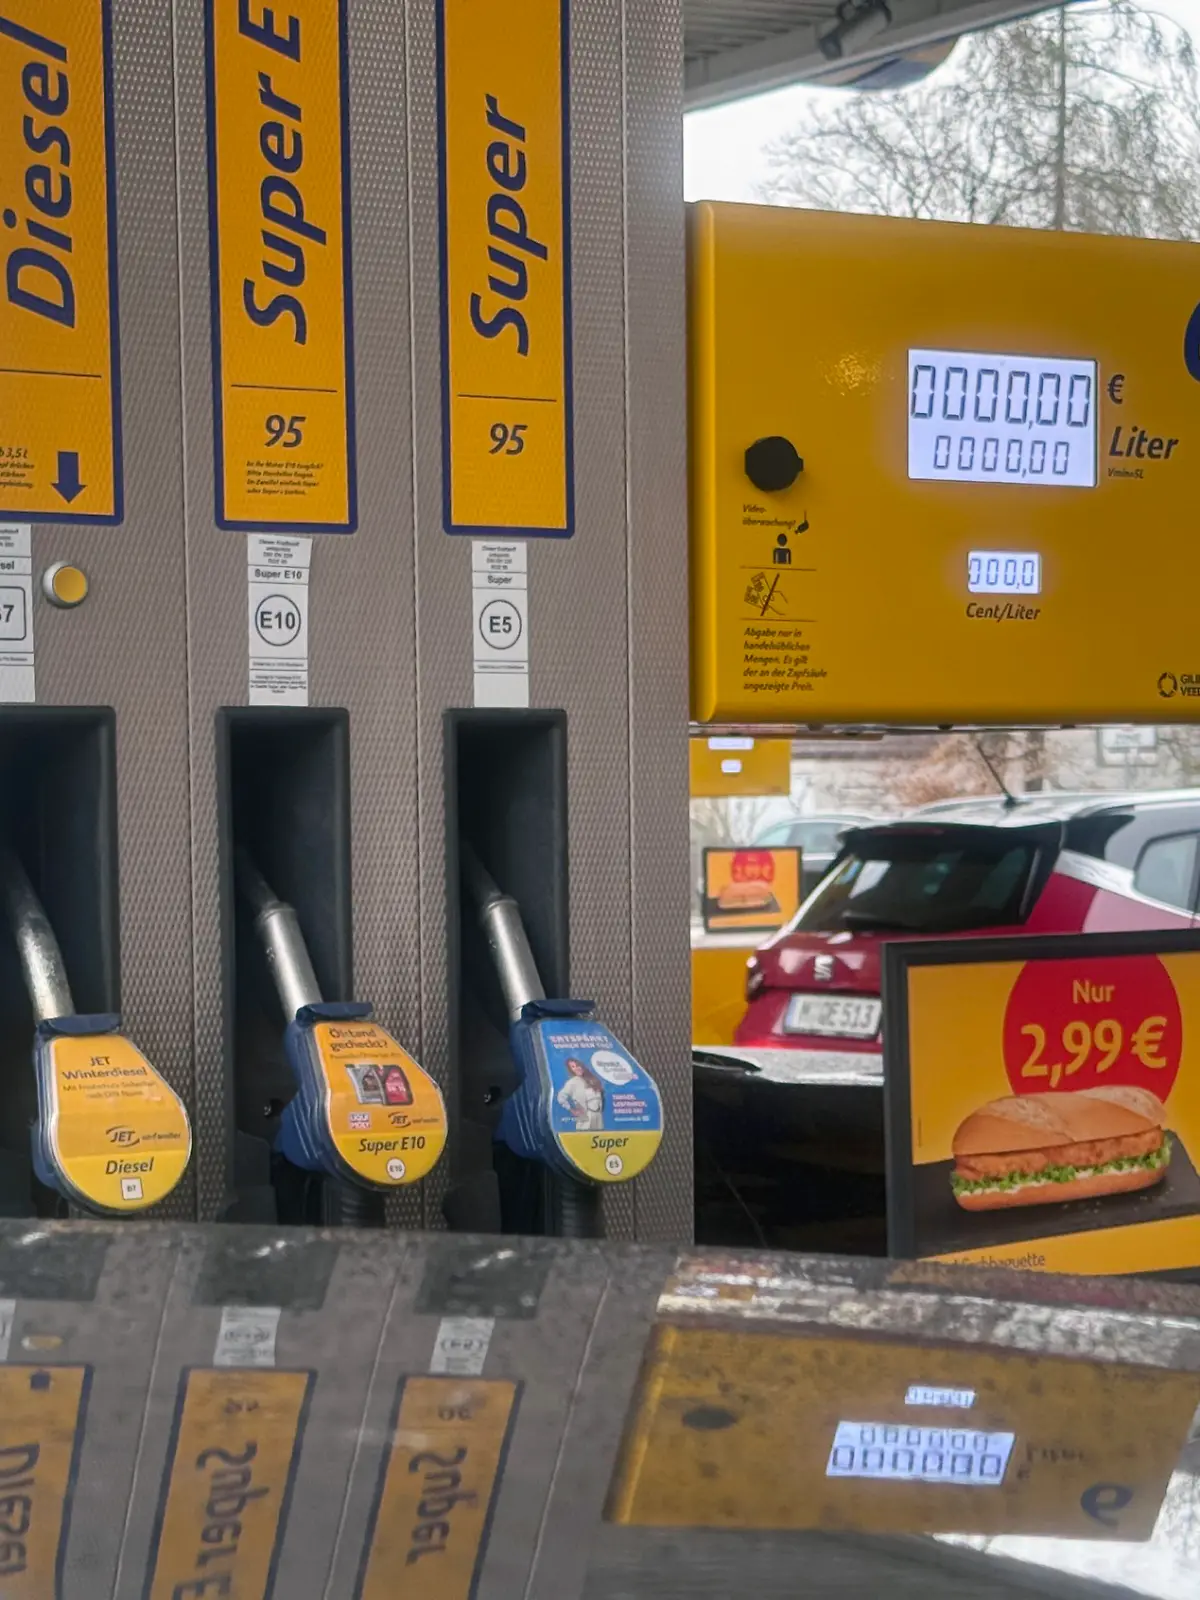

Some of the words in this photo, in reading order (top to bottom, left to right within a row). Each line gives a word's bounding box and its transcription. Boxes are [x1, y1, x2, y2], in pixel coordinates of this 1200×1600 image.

[1, 16, 76, 329] Diesel
[243, 71, 327, 346] Super
[470, 93, 548, 357] Super
[1107, 374, 1125, 404] €
[264, 414, 306, 448] 95
[489, 423, 528, 455] 95
[1109, 426, 1179, 459] Liter
[254, 568, 281, 581] Super
[284, 570, 302, 579] E10
[487, 574, 512, 585] Super
[260, 611, 296, 630] E10
[966, 602, 1041, 622] Cent/Liter
[489, 615, 512, 634] E5
[744, 627, 777, 639] Abgabe
[1072, 979, 1115, 1004] Nur
[90, 1056, 110, 1067] JET
[1020, 1018, 1123, 1088] 2,99
[1131, 1016, 1168, 1069] €
[62, 1067, 148, 1080] Winterdiesel
[359, 1137, 399, 1156] Super
[401, 1136, 426, 1150] E10
[591, 1135, 629, 1153] Super
[106, 1157, 155, 1175] Diesel
[608, 1159, 619, 1169] E5
